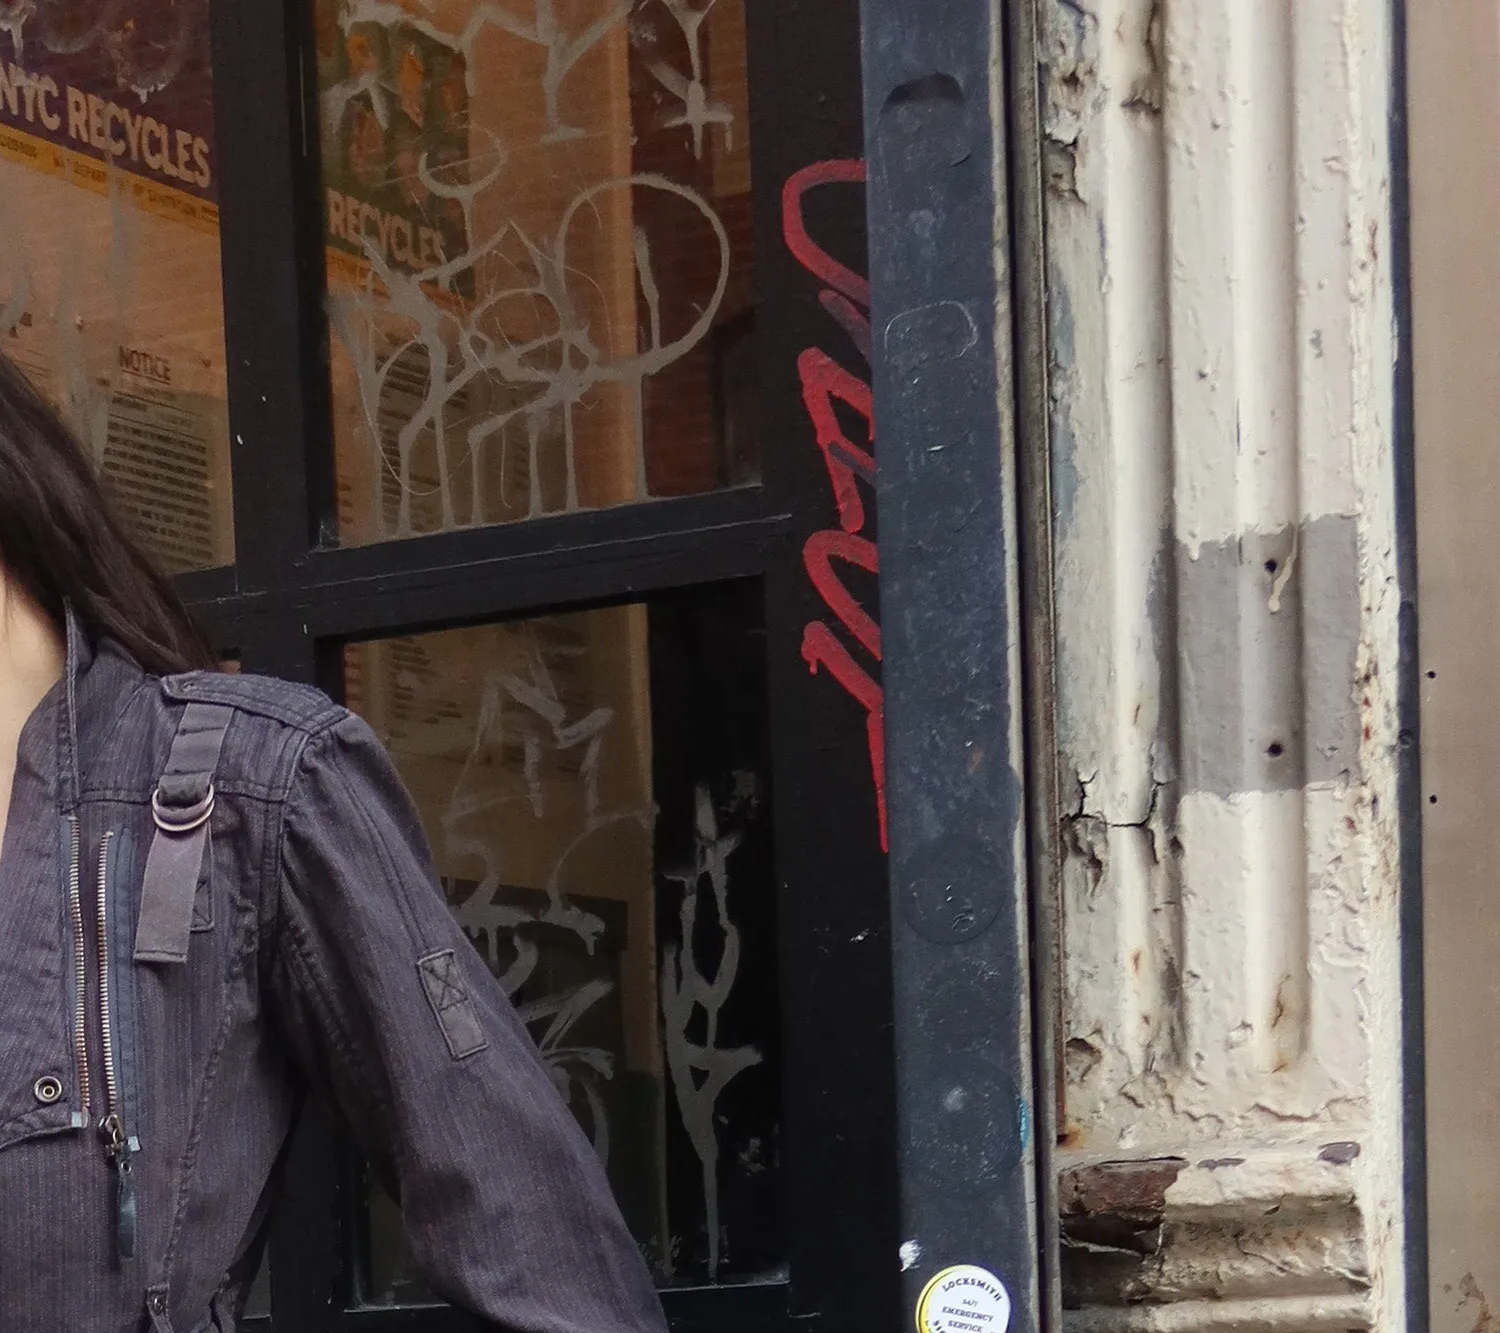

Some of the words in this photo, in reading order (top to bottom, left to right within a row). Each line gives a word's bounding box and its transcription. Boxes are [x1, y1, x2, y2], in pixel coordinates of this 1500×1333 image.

[66, 84, 212, 189] RECYCLES
[119, 345, 171, 382] NOTICE
[942, 1277, 1003, 1302] LOCKSMITH
[941, 1306, 994, 1322] EMERGENCY
[947, 1319, 984, 1333] SERVICE
